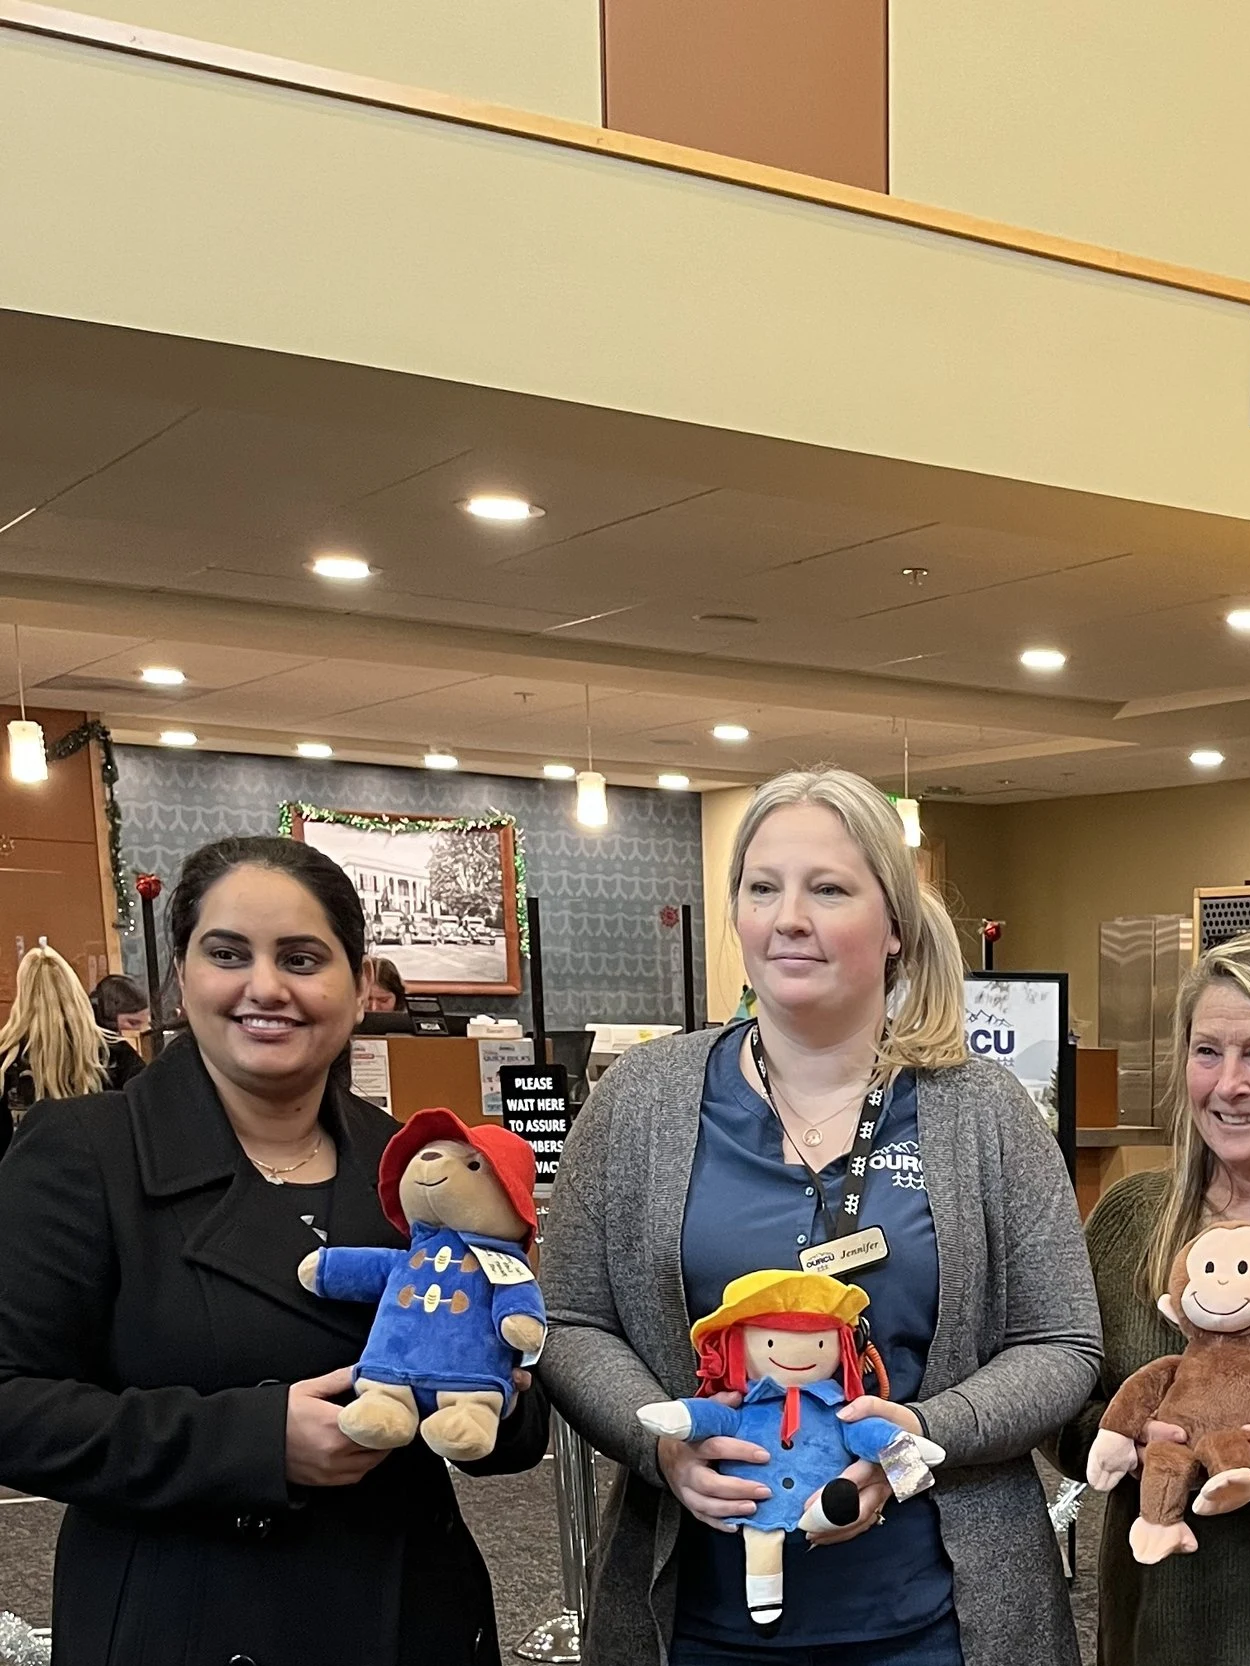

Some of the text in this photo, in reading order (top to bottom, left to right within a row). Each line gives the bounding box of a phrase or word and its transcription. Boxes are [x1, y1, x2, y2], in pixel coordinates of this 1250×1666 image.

[965, 1029, 1015, 1054] CU
[515, 1077, 553, 1090] PLEASE
[507, 1099, 536, 1111] WAIT
[537, 1098, 565, 1111] HERE
[509, 1119, 567, 1132] TO ASSURE
[528, 1140, 564, 1153] MBERS
[840, 1241, 879, 1259] Jennifer
[806, 1254, 835, 1269] OURCU
